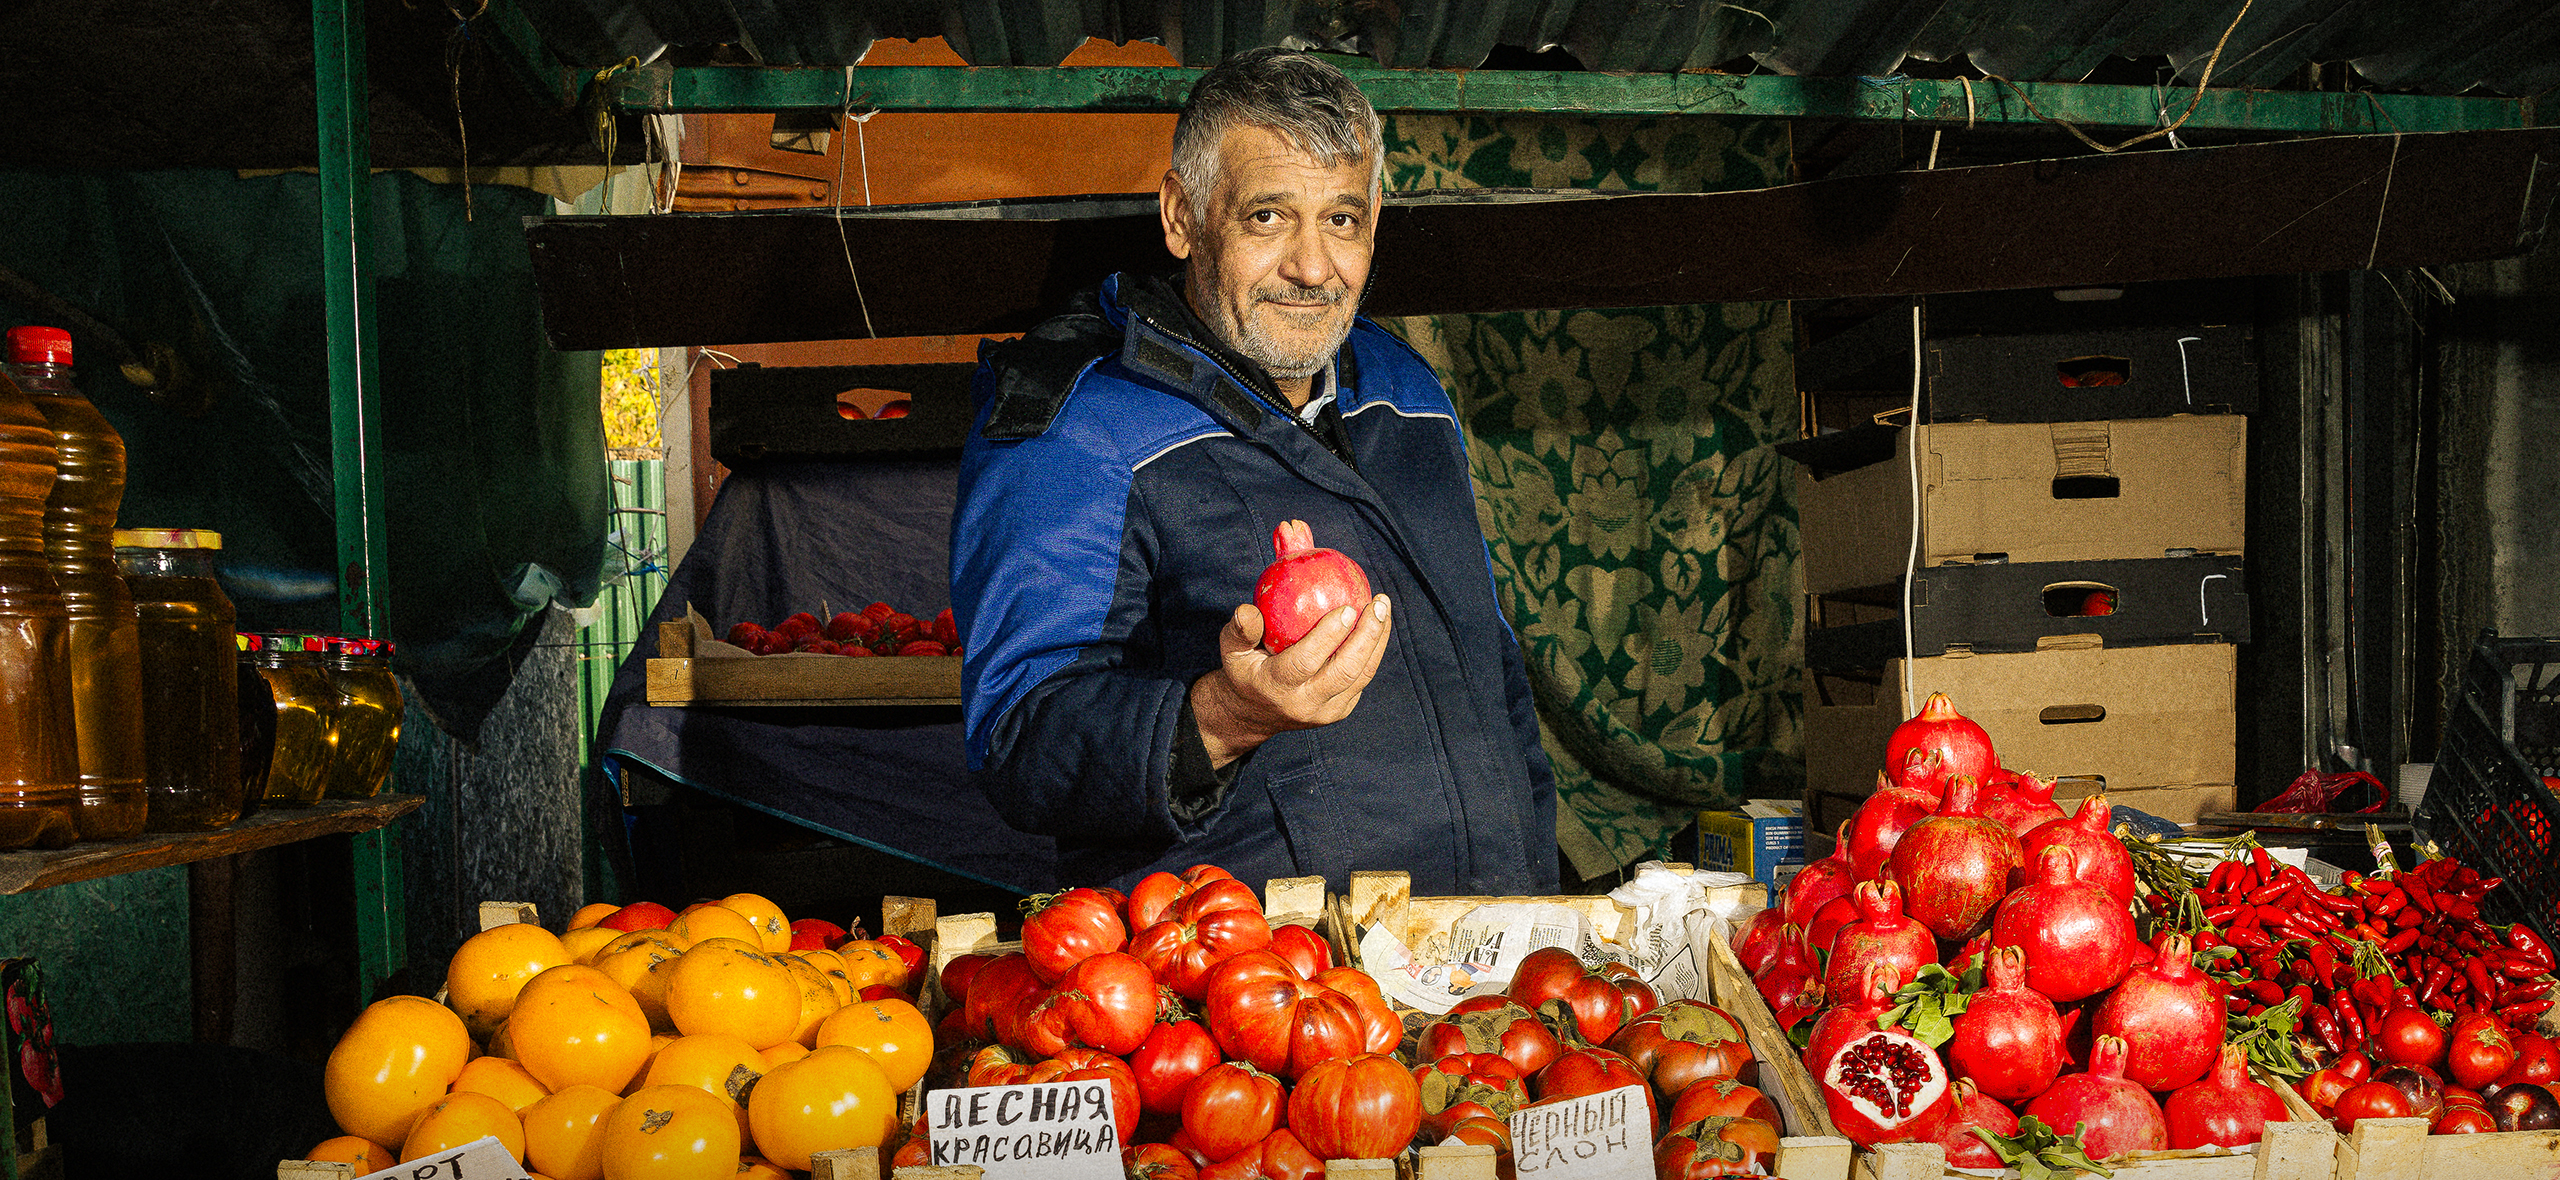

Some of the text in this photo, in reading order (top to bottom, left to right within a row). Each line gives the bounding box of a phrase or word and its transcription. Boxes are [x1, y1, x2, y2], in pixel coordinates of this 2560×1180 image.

[936, 1085, 1109, 1130] ЛЕСНАЯ
[383, 1152, 466, 1180] РТ
[933, 1123, 1115, 1166] КРАСАВИЦА
[1517, 1128, 1628, 1173] СЛОН
